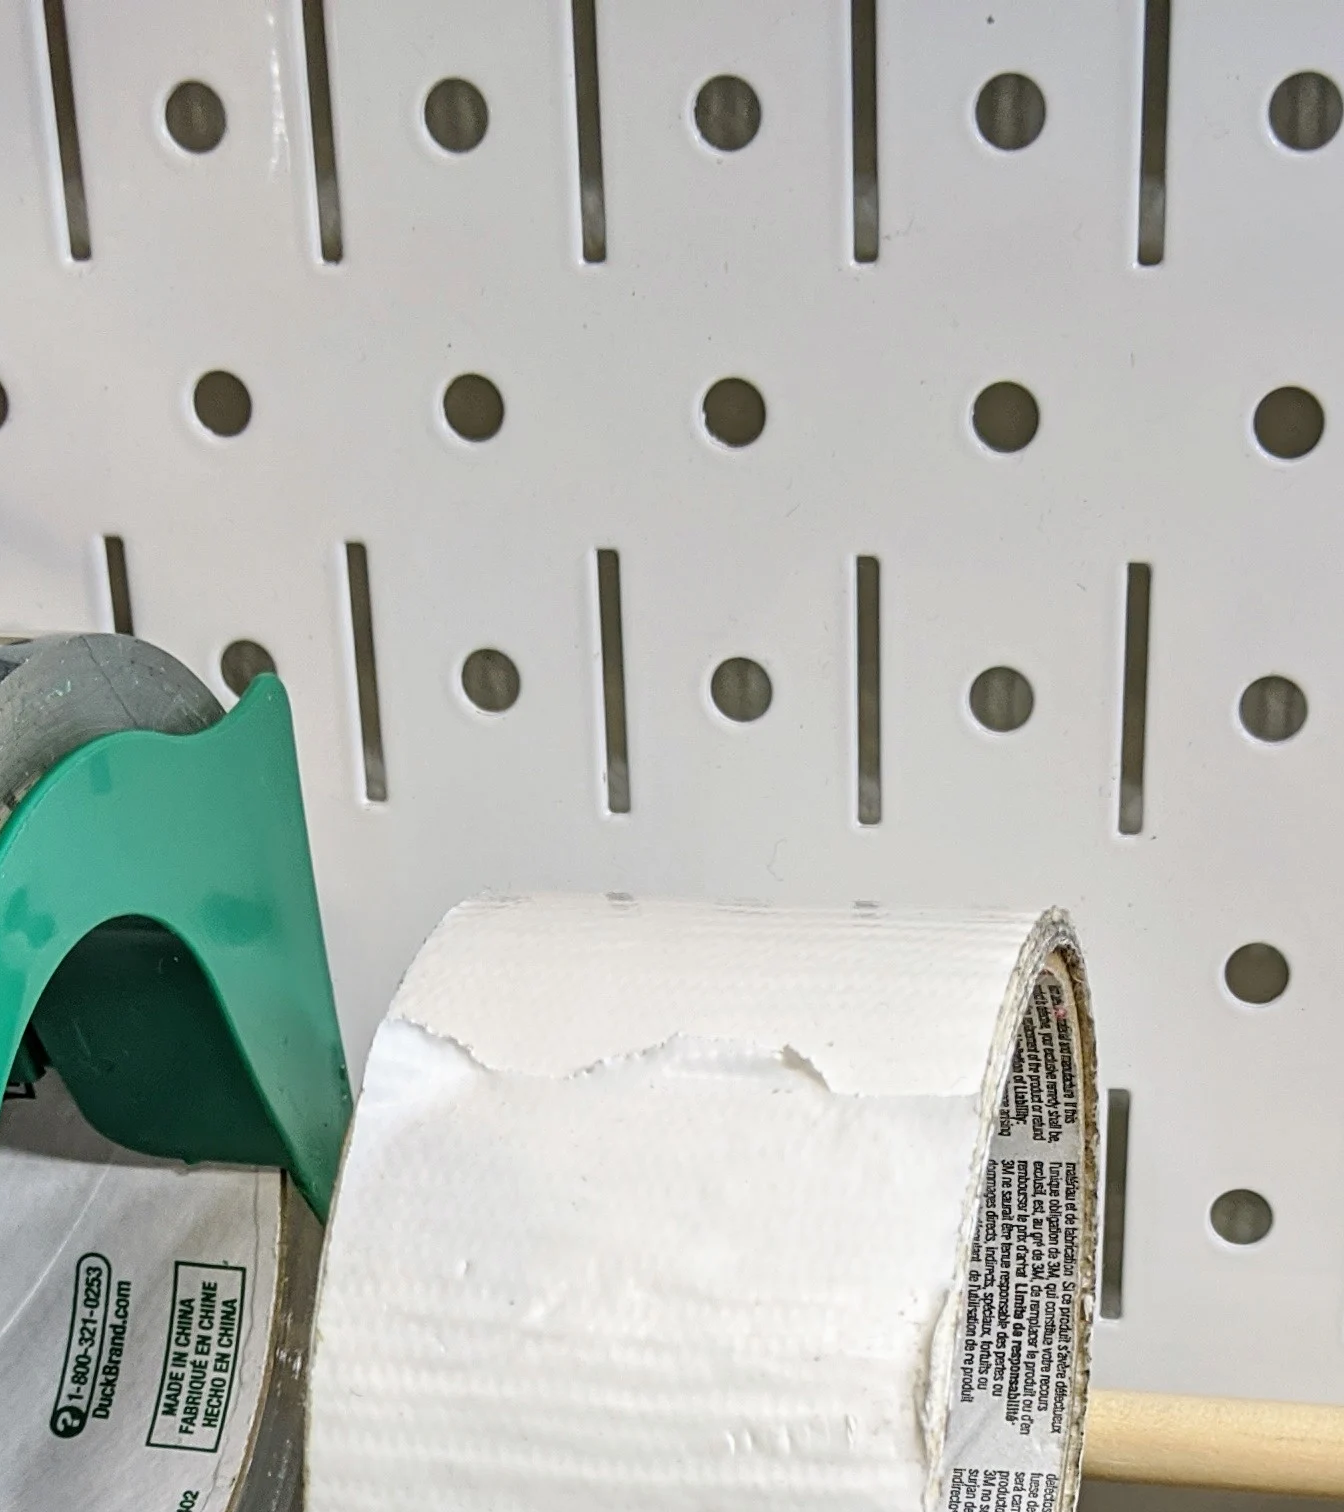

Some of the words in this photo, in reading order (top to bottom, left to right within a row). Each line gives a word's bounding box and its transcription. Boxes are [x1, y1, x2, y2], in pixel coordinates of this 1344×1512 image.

[998, 1109, 1013, 1137] arising
[1001, 1160, 1015, 1175] 3M
[1001, 1177, 1012, 1188] ne
[1017, 1160, 1030, 1212] rembourser
[1001, 1190, 1014, 1221] saurait
[1065, 1203, 1077, 1211] et
[984, 1211, 999, 1244] directs,
[1017, 1214, 1030, 1222] le
[1033, 1218, 1043, 1229] au
[1046, 1199, 1062, 1245] obligation
[1065, 1213, 1077, 1225] de
[1032, 1249, 1045, 1261] de
[1048, 1248, 1061, 1259] de
[968, 1270, 981, 1282] de
[1030, 1263, 1045, 1282] 3M,
[1045, 1261, 1060, 1281] 3M,
[997, 1271, 1011, 1329] responsable
[1013, 1283, 1028, 1319] Limite
[1030, 1285, 1043, 1297] de
[1044, 1283, 1059, 1299] qui
[1061, 1294, 1072, 1304] ce
[197, 1281, 217, 1330] CHINE
[67, 1266, 102, 1400] 1-800-321-0253
[174, 1298, 195, 1347] CHINA
[218, 1298, 237, 1348] CHINA
[1012, 1322, 1026, 1337] de
[1026, 1300, 1041, 1348] remplacer
[1042, 1301, 1056, 1345] constitue
[1058, 1307, 1071, 1343] produit
[92, 1281, 131, 1419] DuckBrand.com
[195, 1335, 212, 1355] EN
[965, 1339, 978, 1351] de
[996, 1332, 1009, 1349] des
[169, 1351, 188, 1367] IN
[214, 1352, 230, 1372] EN
[1026, 1350, 1039, 1359] le
[1041, 1348, 1054, 1372] votre
[1056, 1345, 1070, 1379] s'avère
[993, 1351, 1006, 1381] pertes
[961, 1367, 974, 1403] produit
[977, 1377, 988, 1390] ou
[1023, 1361, 1037, 1397] produit
[161, 1371, 185, 1416] MADE
[179, 1360, 208, 1434] FABRIQUÉ
[992, 1384, 1003, 1397] ou
[1037, 1375, 1050, 1412] recours
[201, 1377, 226, 1428] HECHO
[1022, 1399, 1033, 1412] ou
[1051, 1381, 1067, 1434] défectueux
[1020, 1415, 1033, 1435] d'en
[964, 1468, 980, 1499] surjan
[983, 1469, 997, 1487] 3M
[1013, 1471, 1026, 1492] será
[1028, 1472, 1044, 1498] fuese
[981, 1489, 992, 1502] no
[1041, 1473, 1059, 1512] defectos
